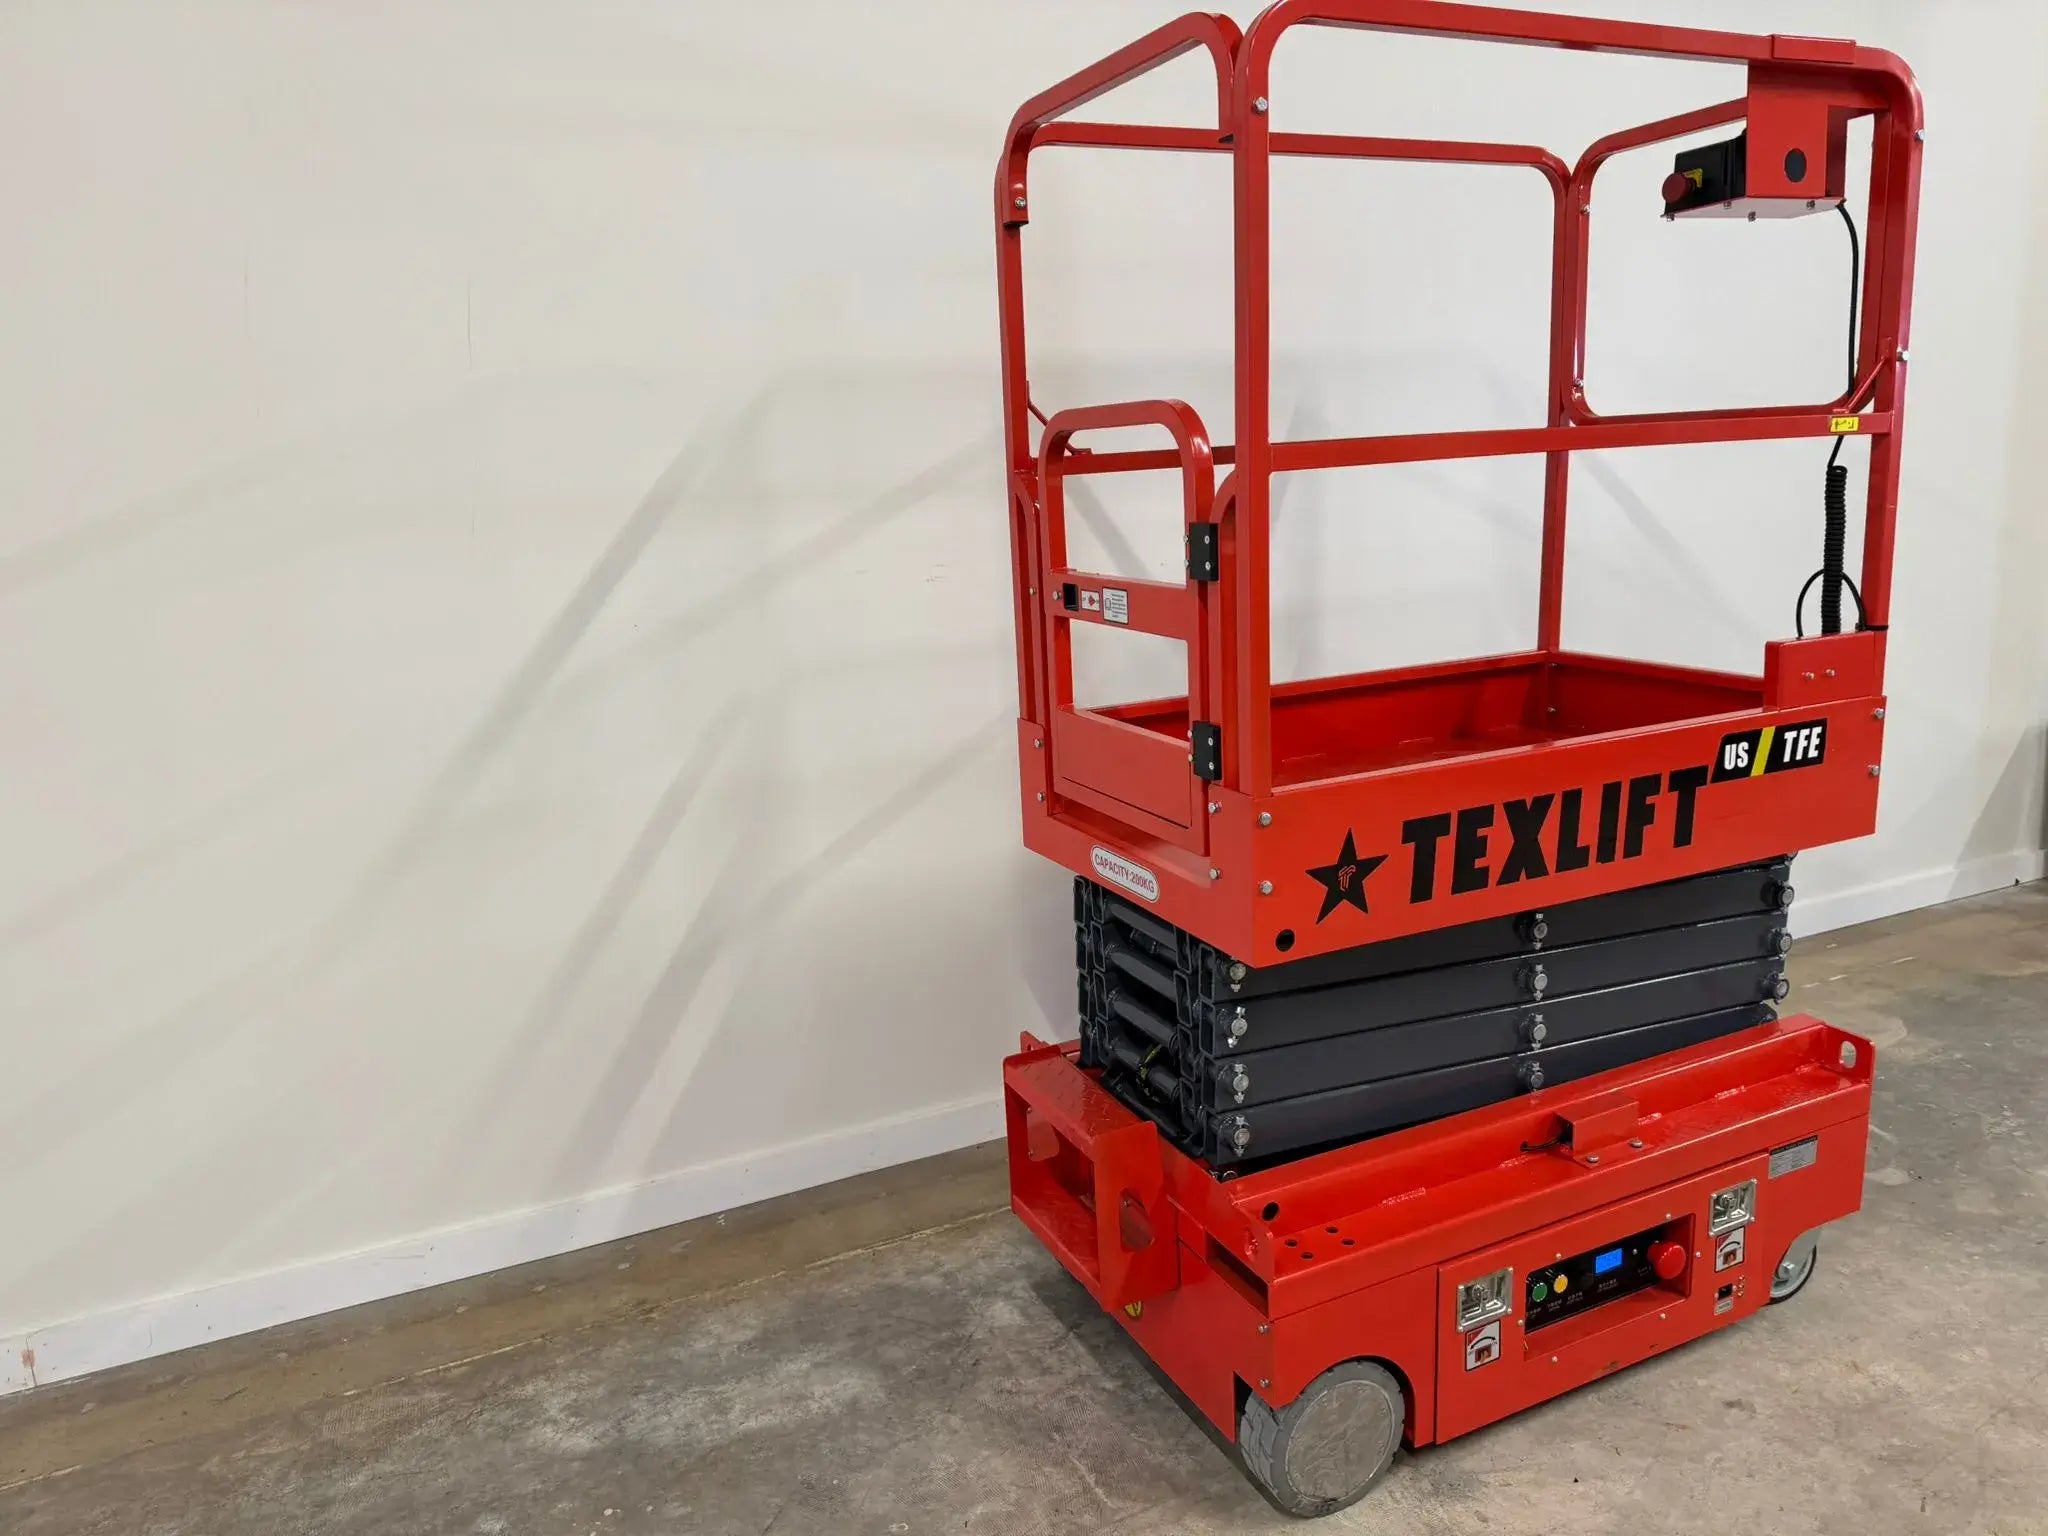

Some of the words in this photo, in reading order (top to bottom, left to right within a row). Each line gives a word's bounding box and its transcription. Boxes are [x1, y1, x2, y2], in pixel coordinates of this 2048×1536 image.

[1724, 741, 1749, 770] US
[1783, 726, 1822, 763] TFE
[1401, 765, 1709, 904] TEXLIFT
